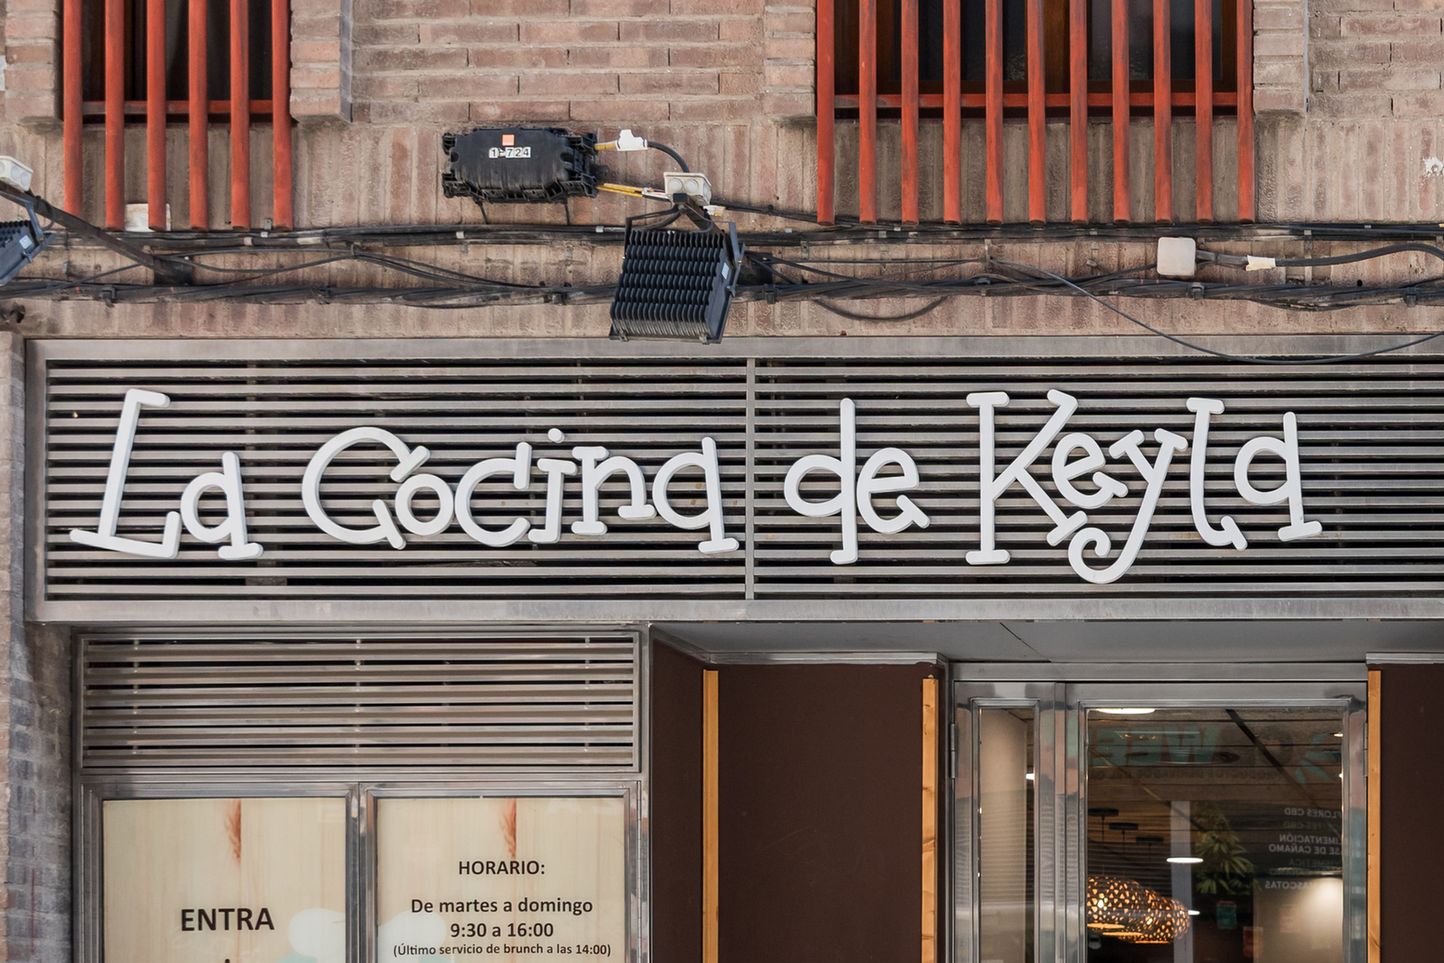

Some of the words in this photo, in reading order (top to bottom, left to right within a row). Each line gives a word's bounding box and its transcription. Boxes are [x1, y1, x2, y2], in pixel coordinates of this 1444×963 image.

[69, 388, 263, 559] La
[301, 426, 740, 555] Cocina
[783, 397, 931, 565] de
[965, 388, 1323, 585] Keyla
[458, 860, 546, 875] HORARIO:
[411, 899, 434, 913] De
[439, 900, 498, 913] martes
[503, 902, 513, 912] a
[518, 897, 594, 916] domingo
[180, 907, 275, 931] ENTRA
[450, 923, 487, 938] 9:30
[492, 926, 501, 937] a
[507, 923, 554, 937] 16:00
[393, 943, 436, 957] (Último
[439, 944, 483, 955] servicio
[486, 944, 500, 954] de
[504, 944, 543, 954] brunch
[547, 946, 553, 954] a
[556, 944, 572, 954] las
[576, 944, 611, 957] 14:00)
